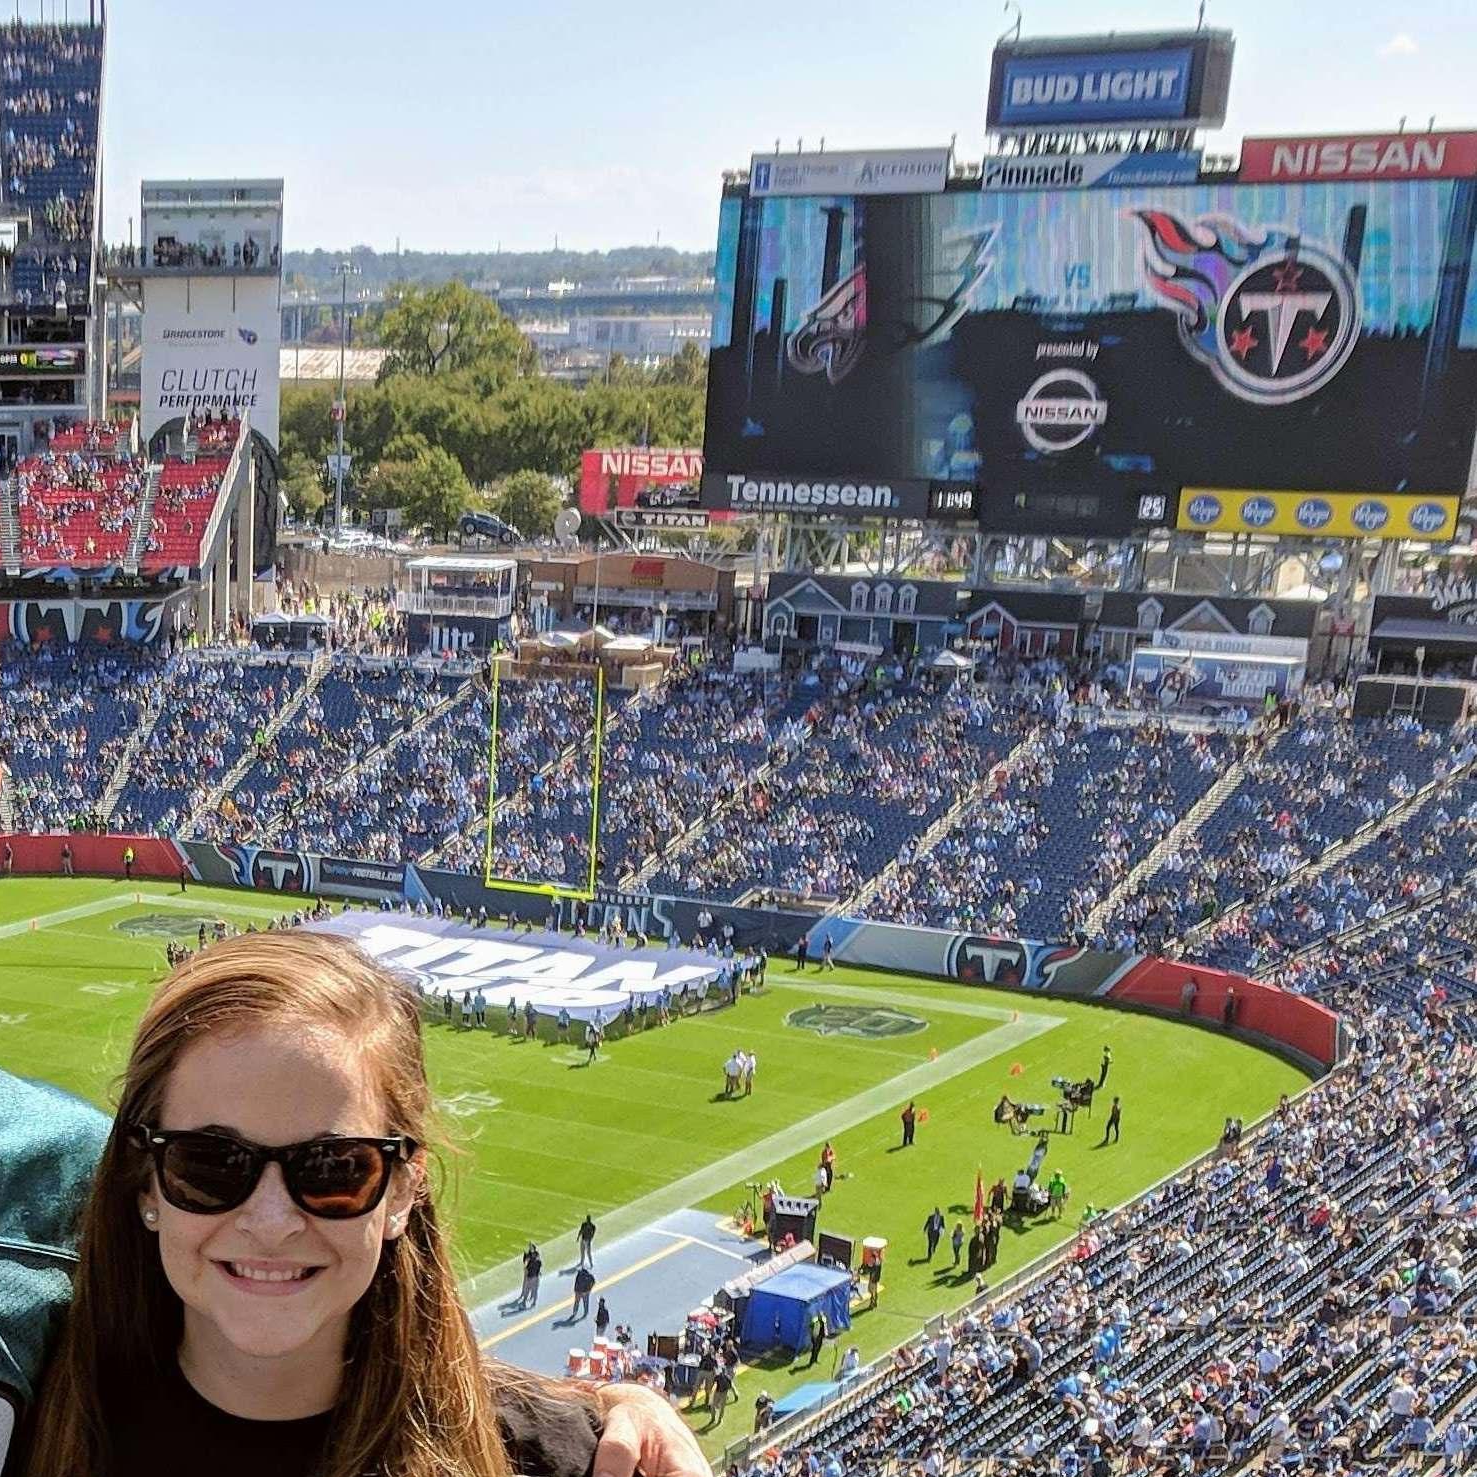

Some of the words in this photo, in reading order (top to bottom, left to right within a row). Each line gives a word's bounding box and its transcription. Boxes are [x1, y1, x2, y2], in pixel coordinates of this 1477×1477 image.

[1011, 73, 1079, 106] BUD
[1081, 68, 1180, 102] LIGHT
[1272, 138, 1448, 176] NISSAN
[986, 158, 1084, 188] Pinnacle
[1035, 340, 1085, 361] presented
[1087, 339, 1101, 362] by
[160, 367, 259, 392] CLUTCH
[159, 393, 259, 409] PERFORMANCE
[1024, 406, 1099, 421] NISSAN
[601, 453, 704, 477] NISSAN
[641, 512, 706, 527] TITAN
[361, 923, 719, 993] TITAN
